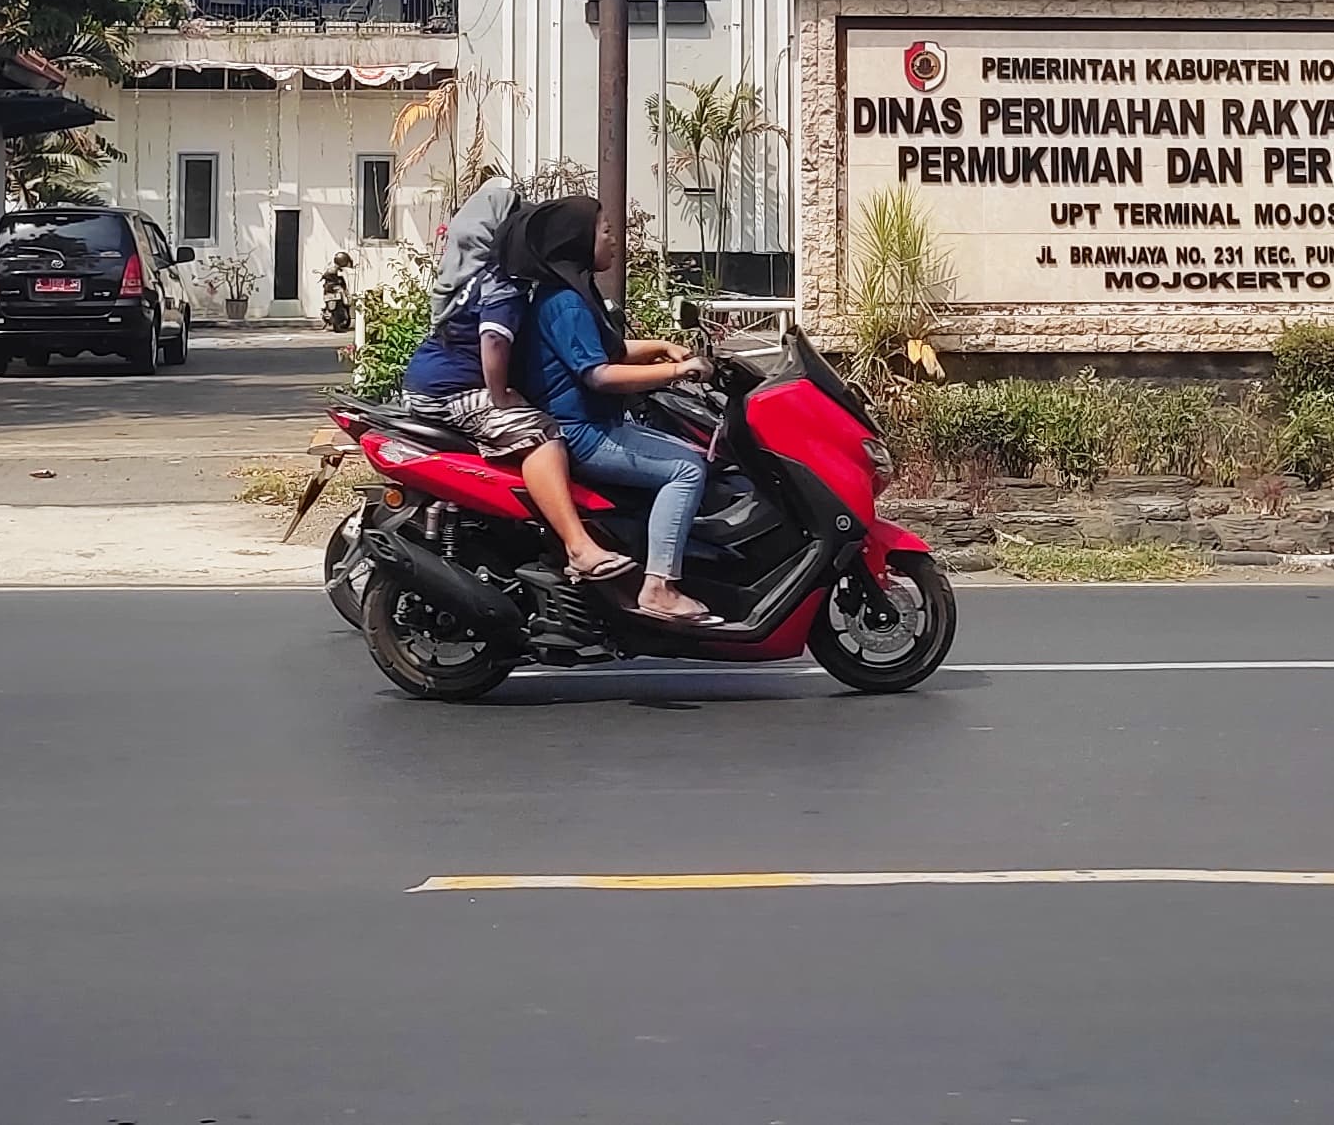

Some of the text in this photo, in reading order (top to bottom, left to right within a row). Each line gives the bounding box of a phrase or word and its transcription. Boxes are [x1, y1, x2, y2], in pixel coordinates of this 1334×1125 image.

[982, 57, 1136, 82] PEMERINTAH
[1145, 58, 1290, 82] KABUPATEN
[853, 97, 964, 135] DINAS
[979, 97, 1205, 136] PERUMAHAN
[898, 145, 1143, 185] PERMUKIMAN
[1167, 147, 1243, 185] DAN
[1050, 202, 1101, 226] UPT
[1113, 202, 1241, 226] TERMINAL
[1036, 245, 1057, 265] JL
[1070, 246, 1169, 266] BRAWIJAYA
[1176, 246, 1207, 266] NO.
[1214, 246, 1243, 265] 231
[1254, 246, 1296, 266] KEC.
[1104, 271, 1332, 290] MOJOKERTO
